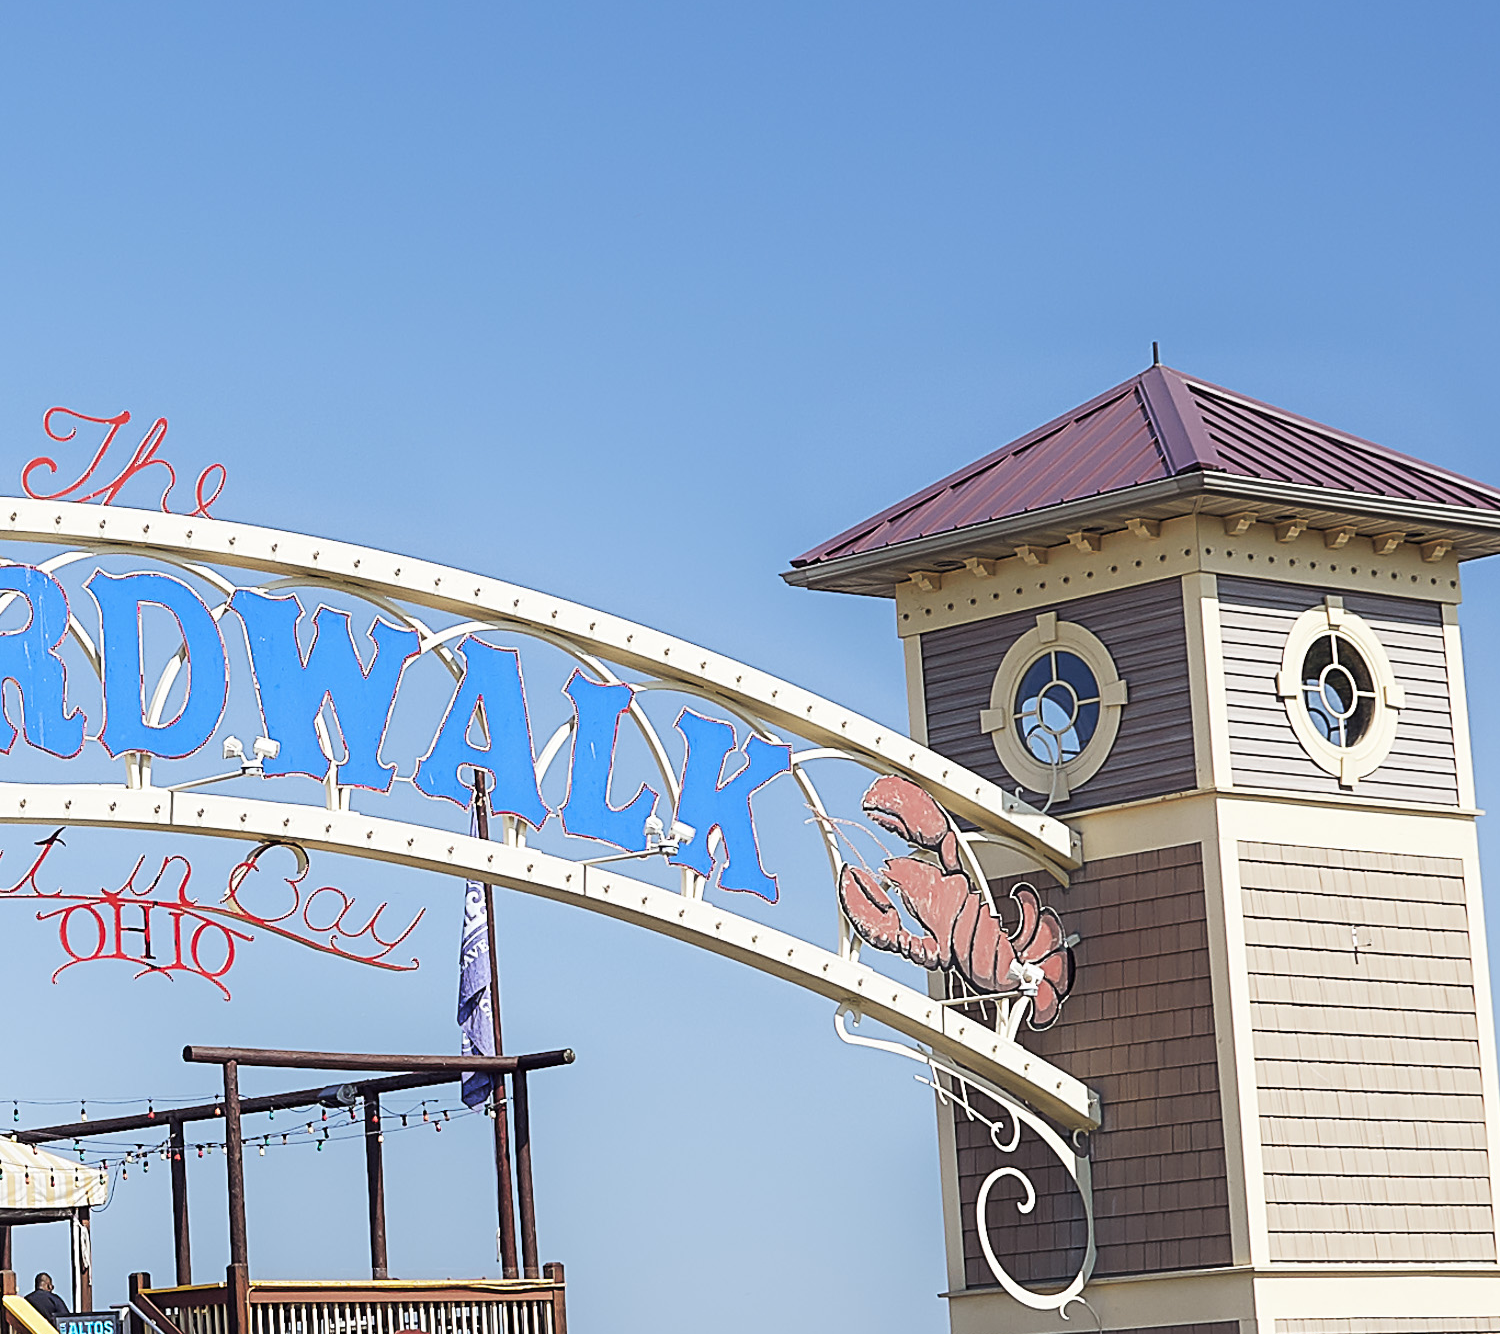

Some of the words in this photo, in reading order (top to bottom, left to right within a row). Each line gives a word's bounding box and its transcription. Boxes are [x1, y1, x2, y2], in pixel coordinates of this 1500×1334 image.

[21, 405, 228, 520] The
[58, 903, 238, 979] OHIO
[102, 853, 198, 907] in
[225, 840, 427, 962] Bay
